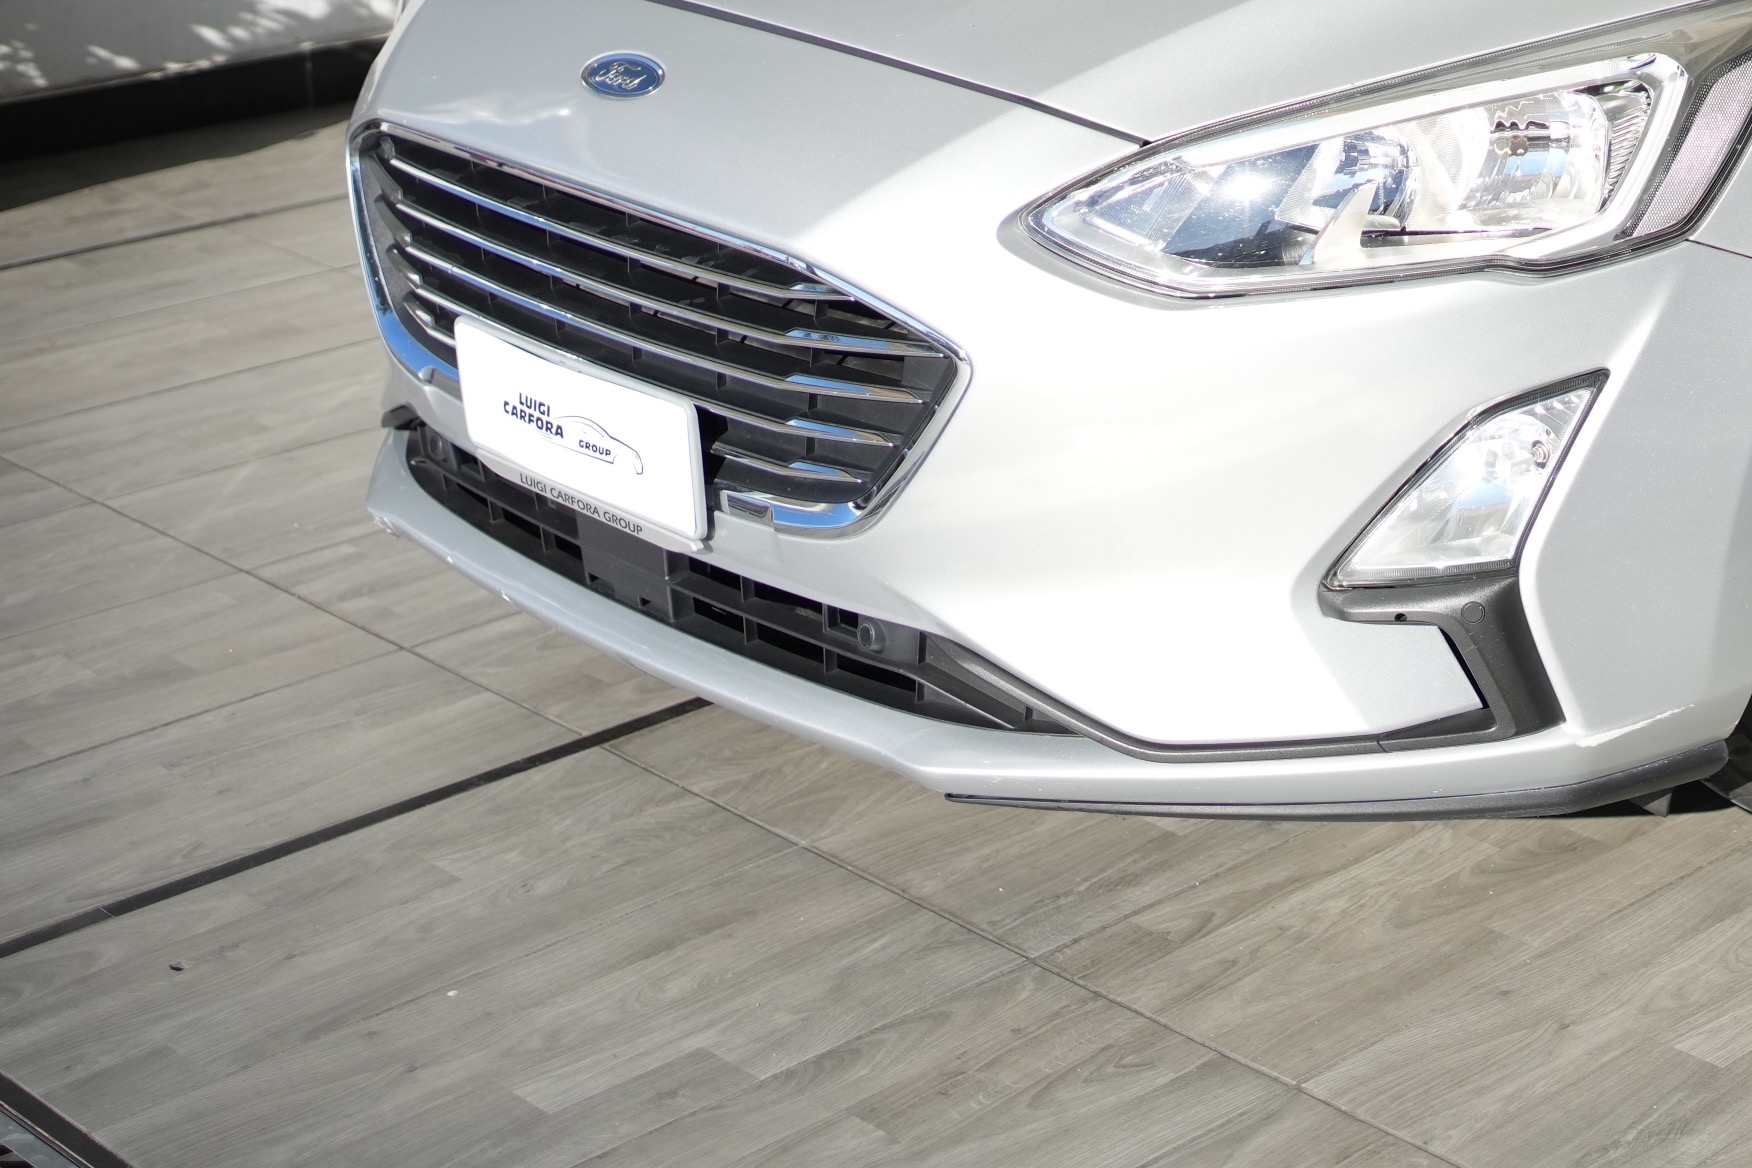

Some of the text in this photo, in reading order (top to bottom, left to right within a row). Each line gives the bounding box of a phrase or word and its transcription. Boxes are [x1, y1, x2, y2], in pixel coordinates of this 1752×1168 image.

[595, 61, 647, 89] Ford
[519, 393, 551, 417] LUIGI
[503, 400, 564, 439] CARFORA
[578, 439, 612, 457] GROUP
[520, 473, 643, 535] LUIGI CARFORA GROUP
